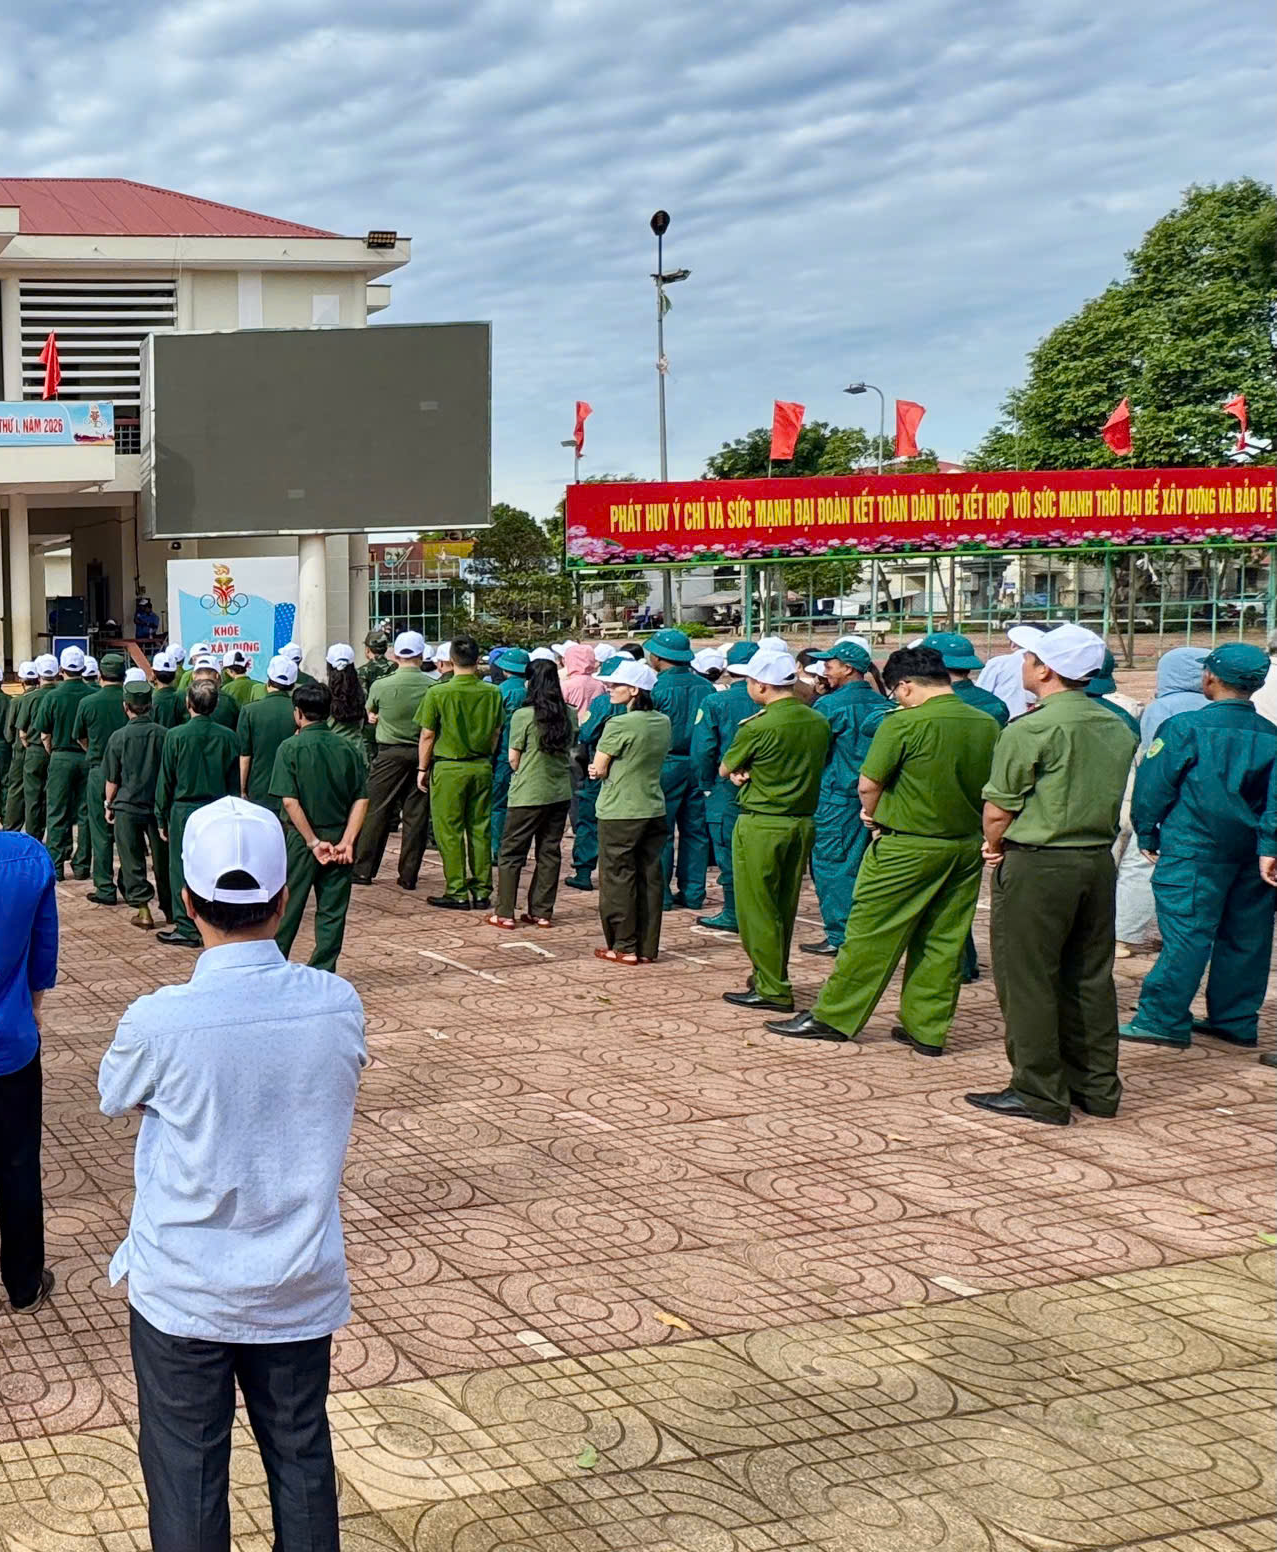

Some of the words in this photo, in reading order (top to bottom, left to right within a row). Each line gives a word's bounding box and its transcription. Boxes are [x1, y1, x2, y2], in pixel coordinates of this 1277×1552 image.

[23, 415, 42, 433] NĂM
[43, 418, 64, 434] 2026
[610, 498, 643, 533] PHÁT
[645, 503, 669, 532] HUY
[673, 497, 681, 531] Ý
[684, 496, 705, 531] CHÍ
[707, 496, 724, 530] VÀ
[727, 494, 752, 529] SỨC
[755, 499, 791, 533] MẠNH
[794, 497, 815, 532] ĐẠI
[817, 490, 850, 525] ĐOÀN
[853, 487, 874, 524] KẾT
[877, 489, 908, 523] TOÀN
[911, 488, 935, 522] DÂN
[938, 487, 960, 527] TỘC
[963, 484, 984, 520] KẾT
[986, 489, 1010, 525] HỢP
[1012, 486, 1031, 519] VỚI
[1033, 486, 1056, 518] SỨC
[1059, 490, 1093, 523] MẠNH
[1096, 483, 1120, 517] THỜI
[1123, 489, 1142, 522] ĐẠI
[1145, 478, 1161, 515] ĐỂ
[1161, 483, 1183, 515] XÂY
[1186, 486, 1216, 520] DỰNG
[1218, 481, 1233, 514] VÀ
[1235, 478, 1257, 513] BẢO
[1259, 481, 1274, 519] VỆ
